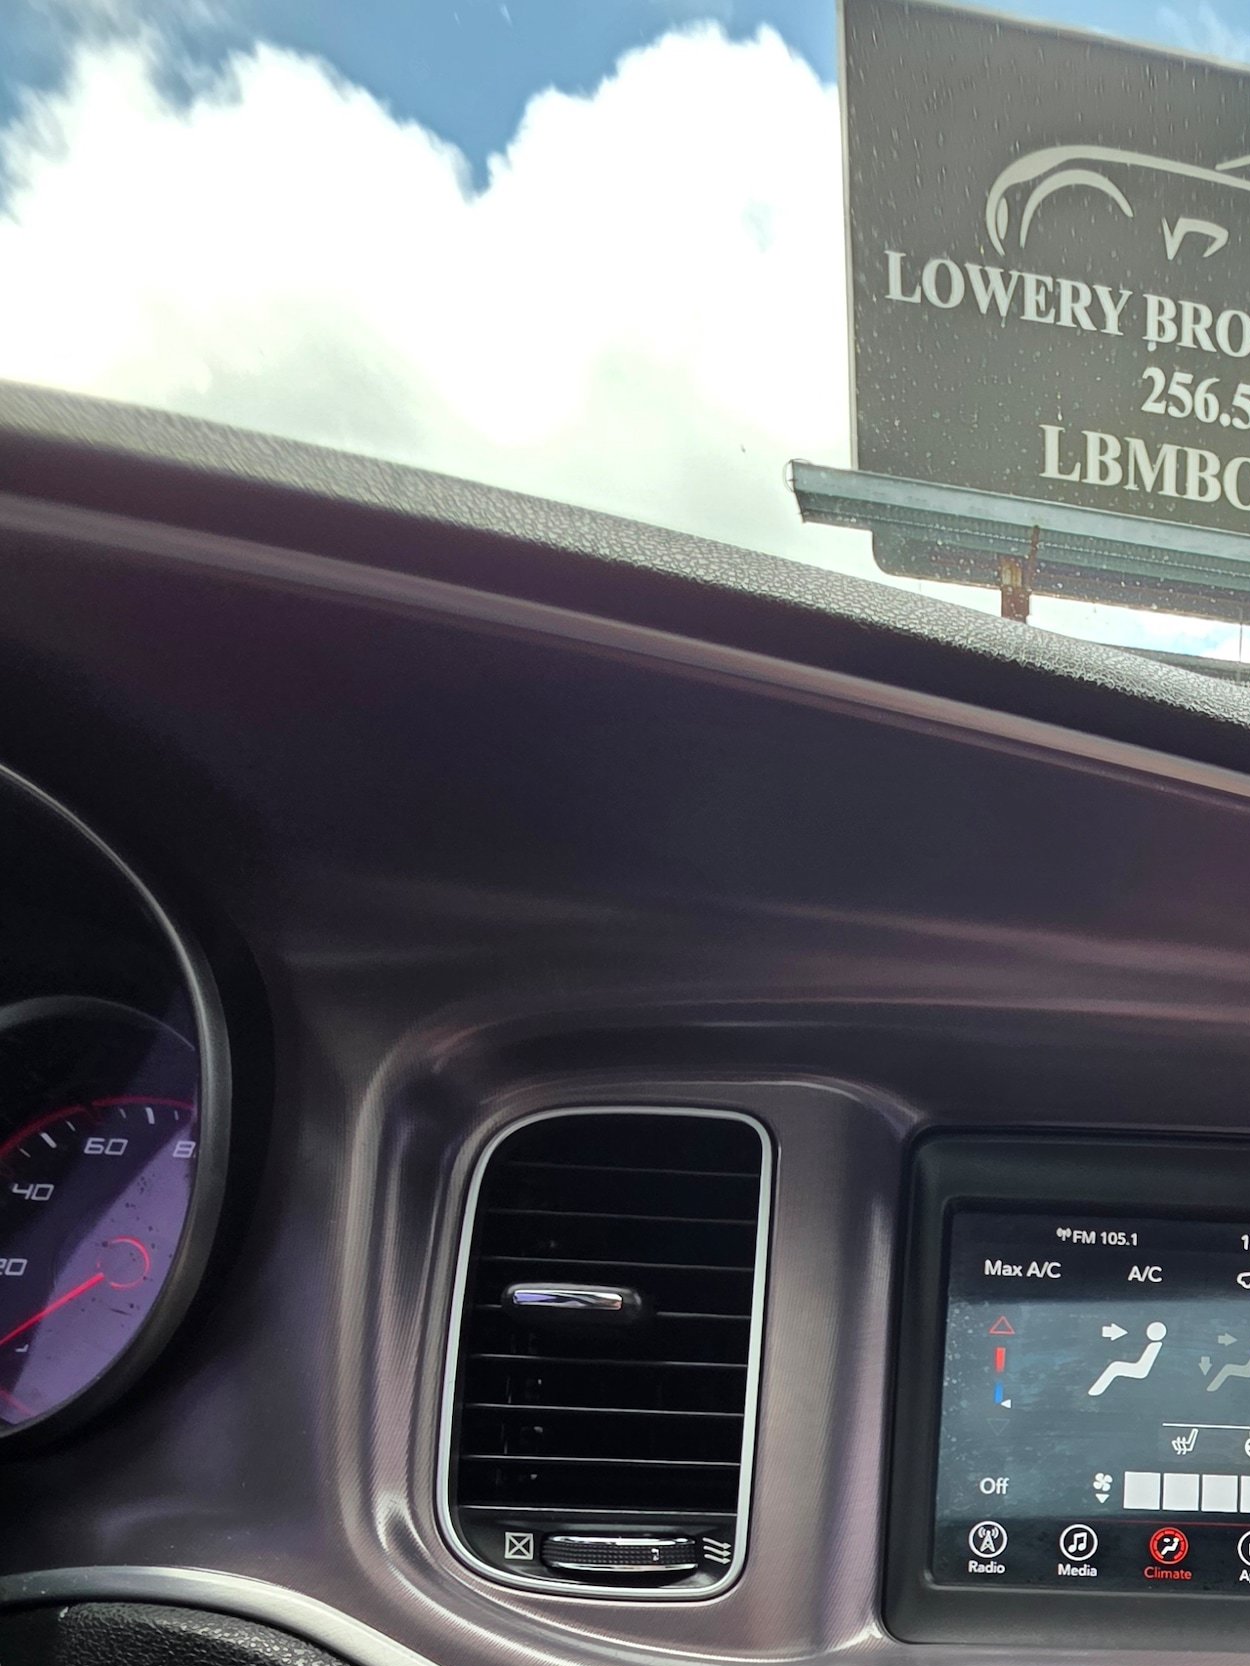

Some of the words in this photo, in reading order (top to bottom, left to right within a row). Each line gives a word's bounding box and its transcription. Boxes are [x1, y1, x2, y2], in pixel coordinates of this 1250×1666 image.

[884, 250, 1131, 336] LOWERY
[84, 1137, 128, 1156] 60
[172, 1140, 197, 1158] 8
[12, 1183, 55, 1201] 40
[1072, 1230, 1096, 1245] FM
[1100, 1231, 1138, 1246] 105.1
[984, 1259, 1023, 1278] Max
[1026, 1261, 1062, 1279] A/C
[1127, 1265, 1163, 1283] A/C
[979, 1477, 1010, 1495] Off
[968, 1560, 1006, 1575] Radio
[1057, 1563, 1098, 1577] Media
[1144, 1566, 1192, 1580] Climate
